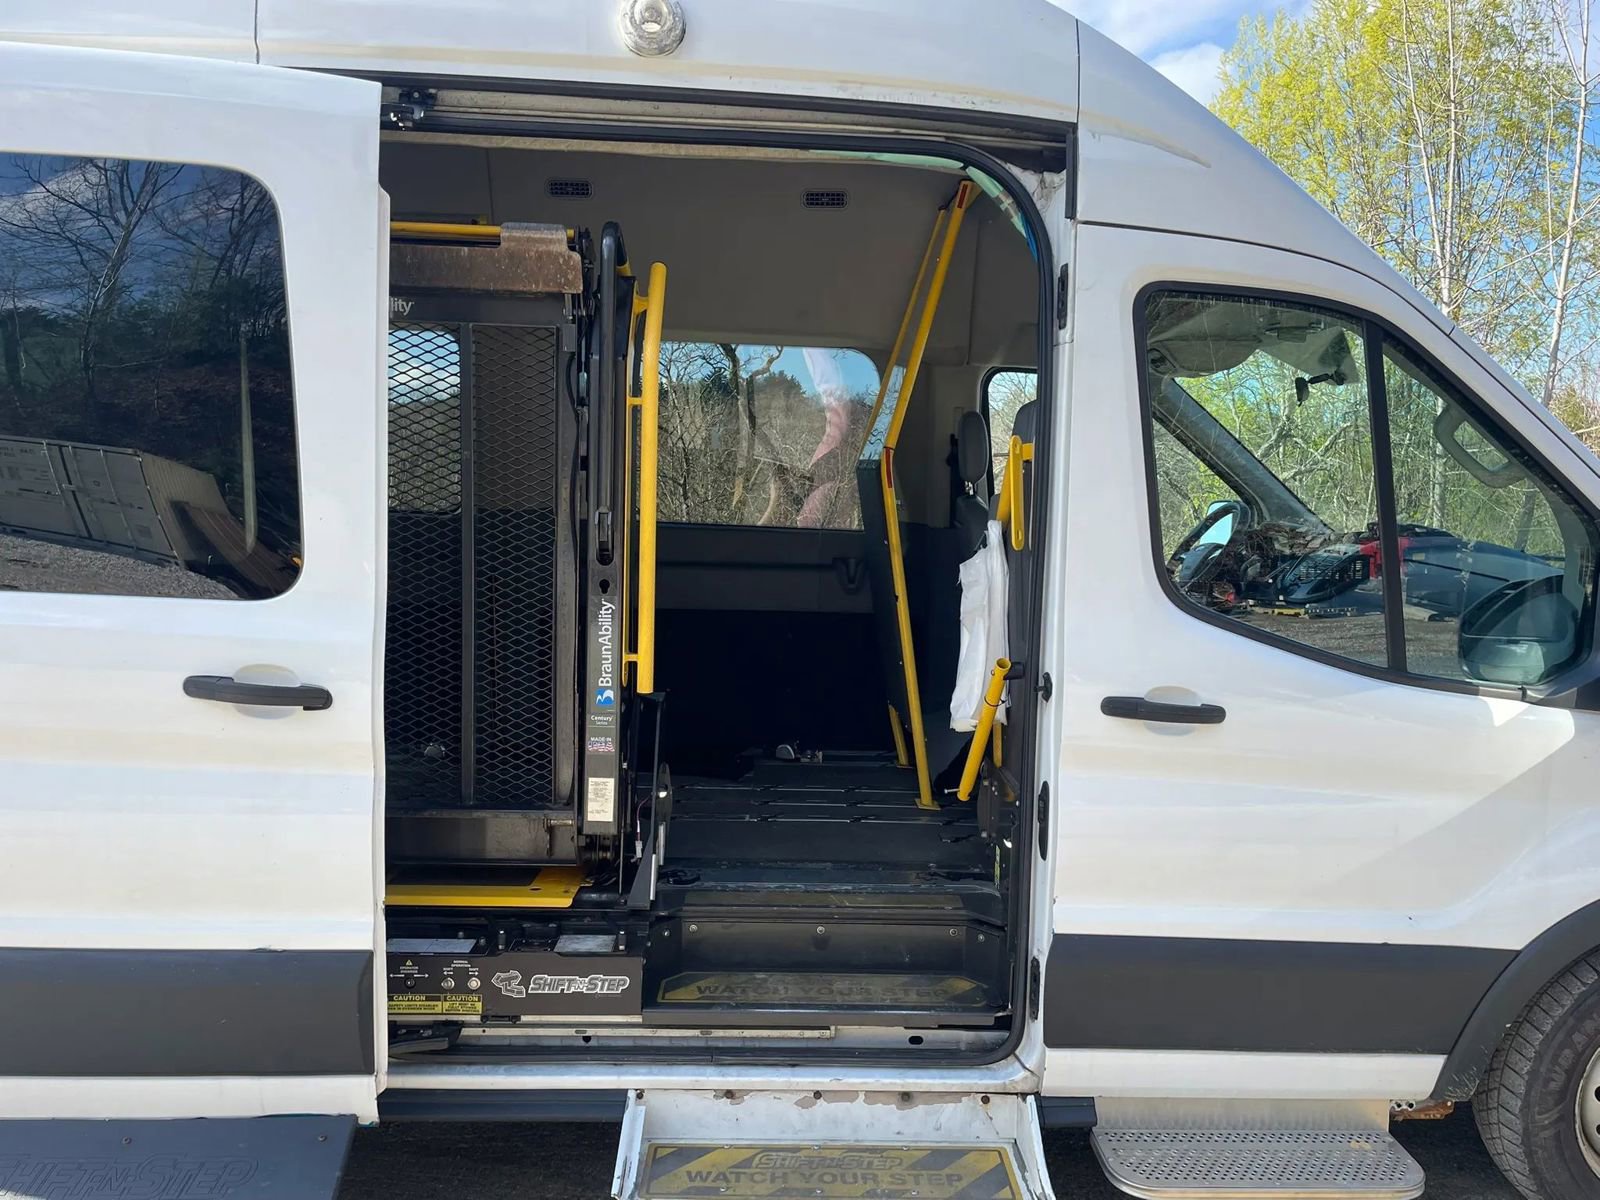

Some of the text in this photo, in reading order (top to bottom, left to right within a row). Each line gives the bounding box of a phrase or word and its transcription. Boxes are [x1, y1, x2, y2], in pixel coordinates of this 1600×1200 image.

[598, 599, 616, 687] BraunAbility
[697, 985, 949, 998] WATCH YOUR STEP
[686, 1170, 964, 1187] WATCH YOUR STEP
